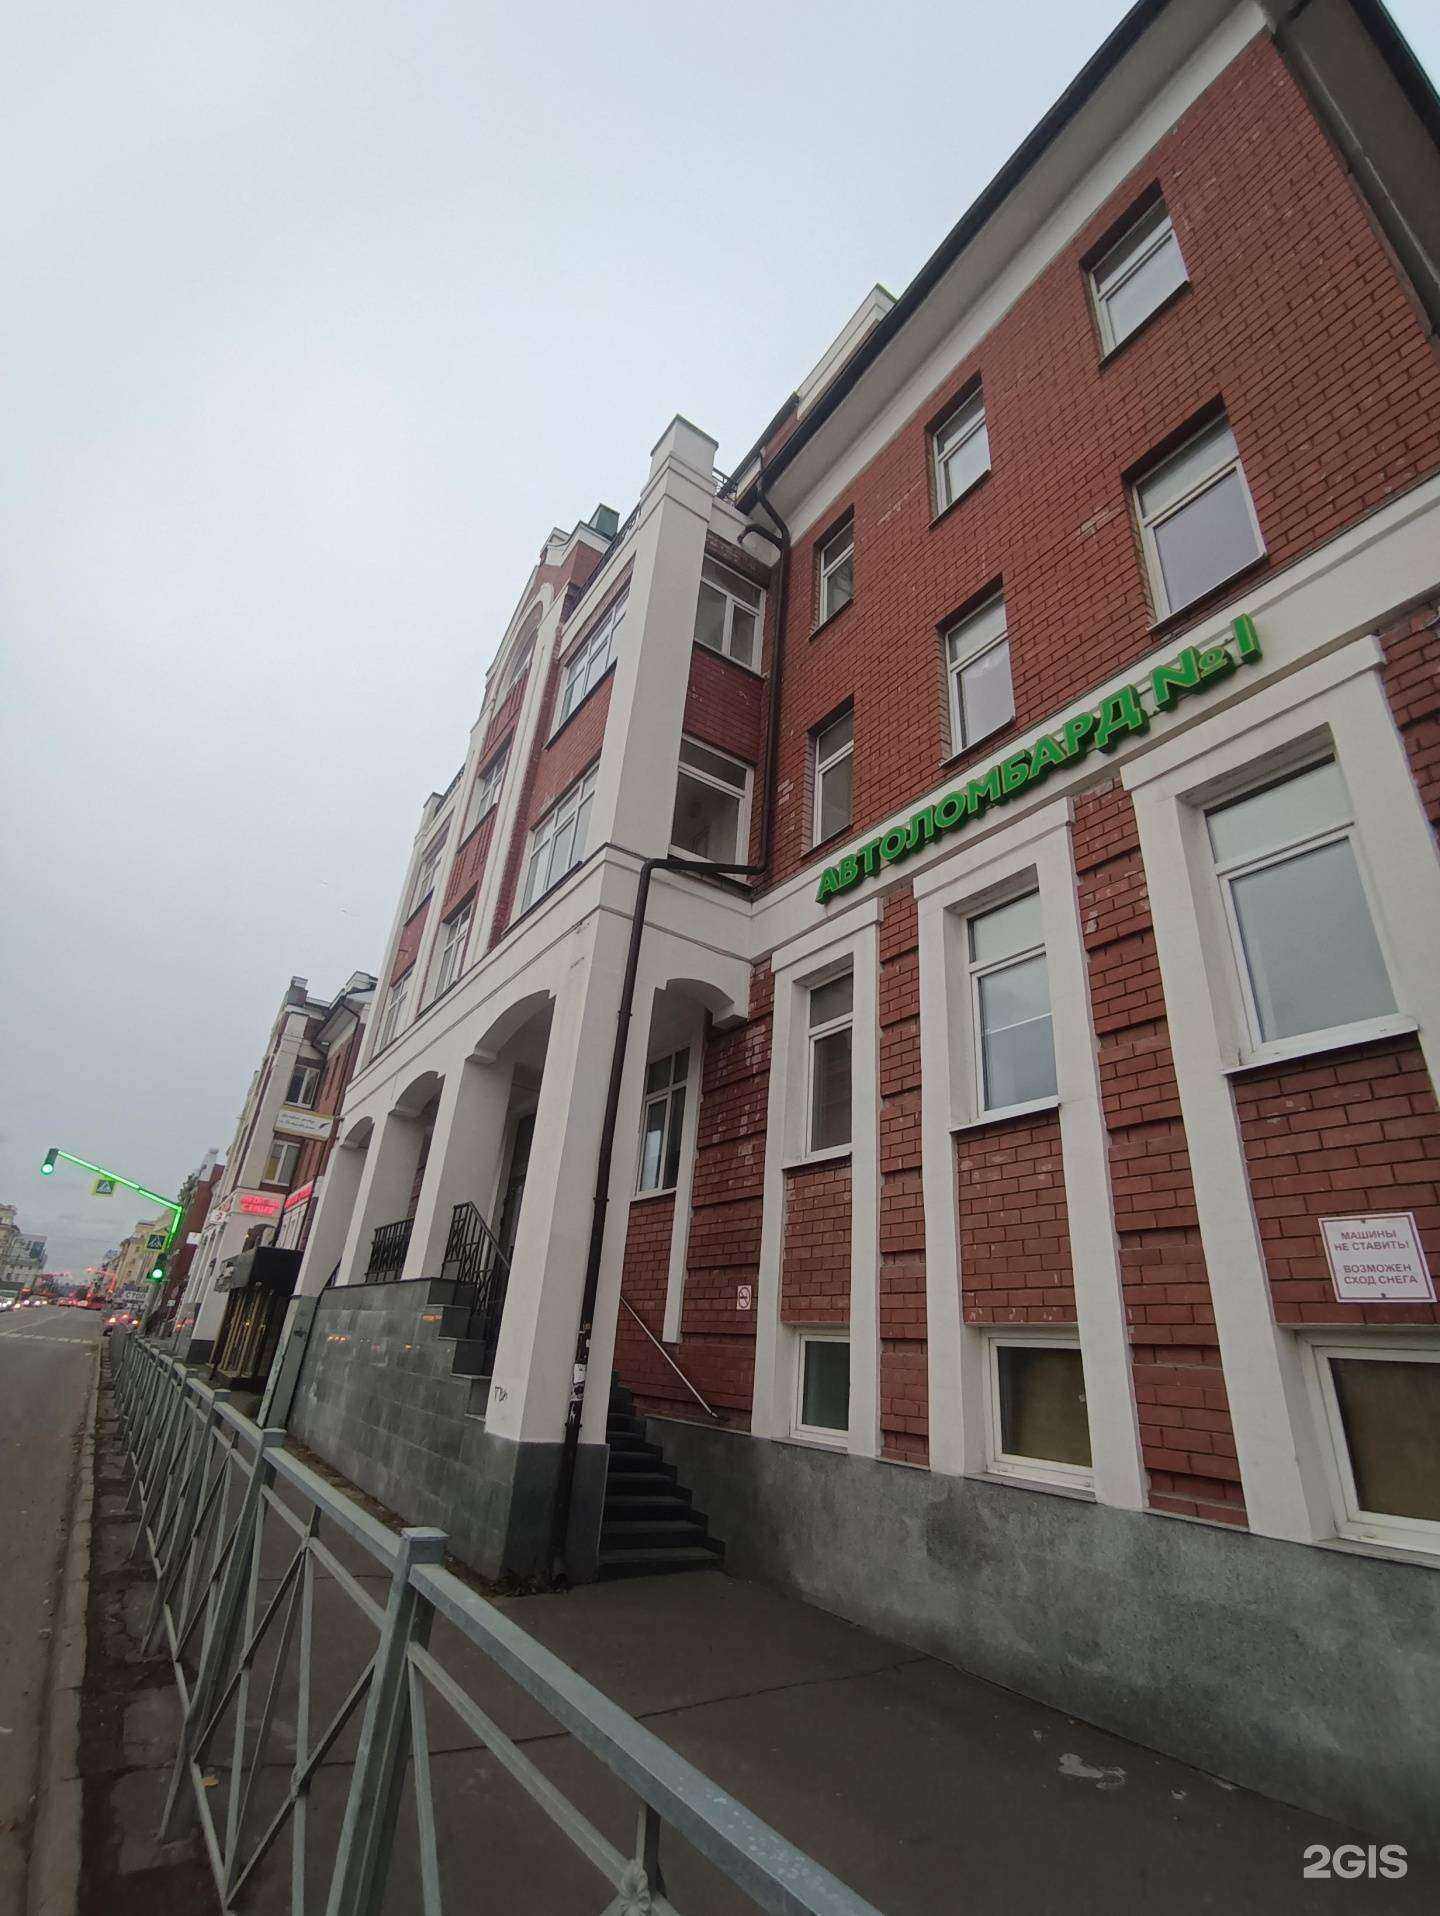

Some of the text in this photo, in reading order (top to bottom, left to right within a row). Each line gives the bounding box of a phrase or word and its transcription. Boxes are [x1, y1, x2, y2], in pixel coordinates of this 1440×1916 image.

[816, 684, 1148, 902] АВТОЛОМБАРД
[1340, 1229, 1398, 1241] МАШИНЫ
[1334, 1242, 1350, 1252] НЕ
[1343, 1263, 1412, 1274] ВОЗМОЖЕН
[1344, 1274, 1418, 1286] СХОД СНЕГА
